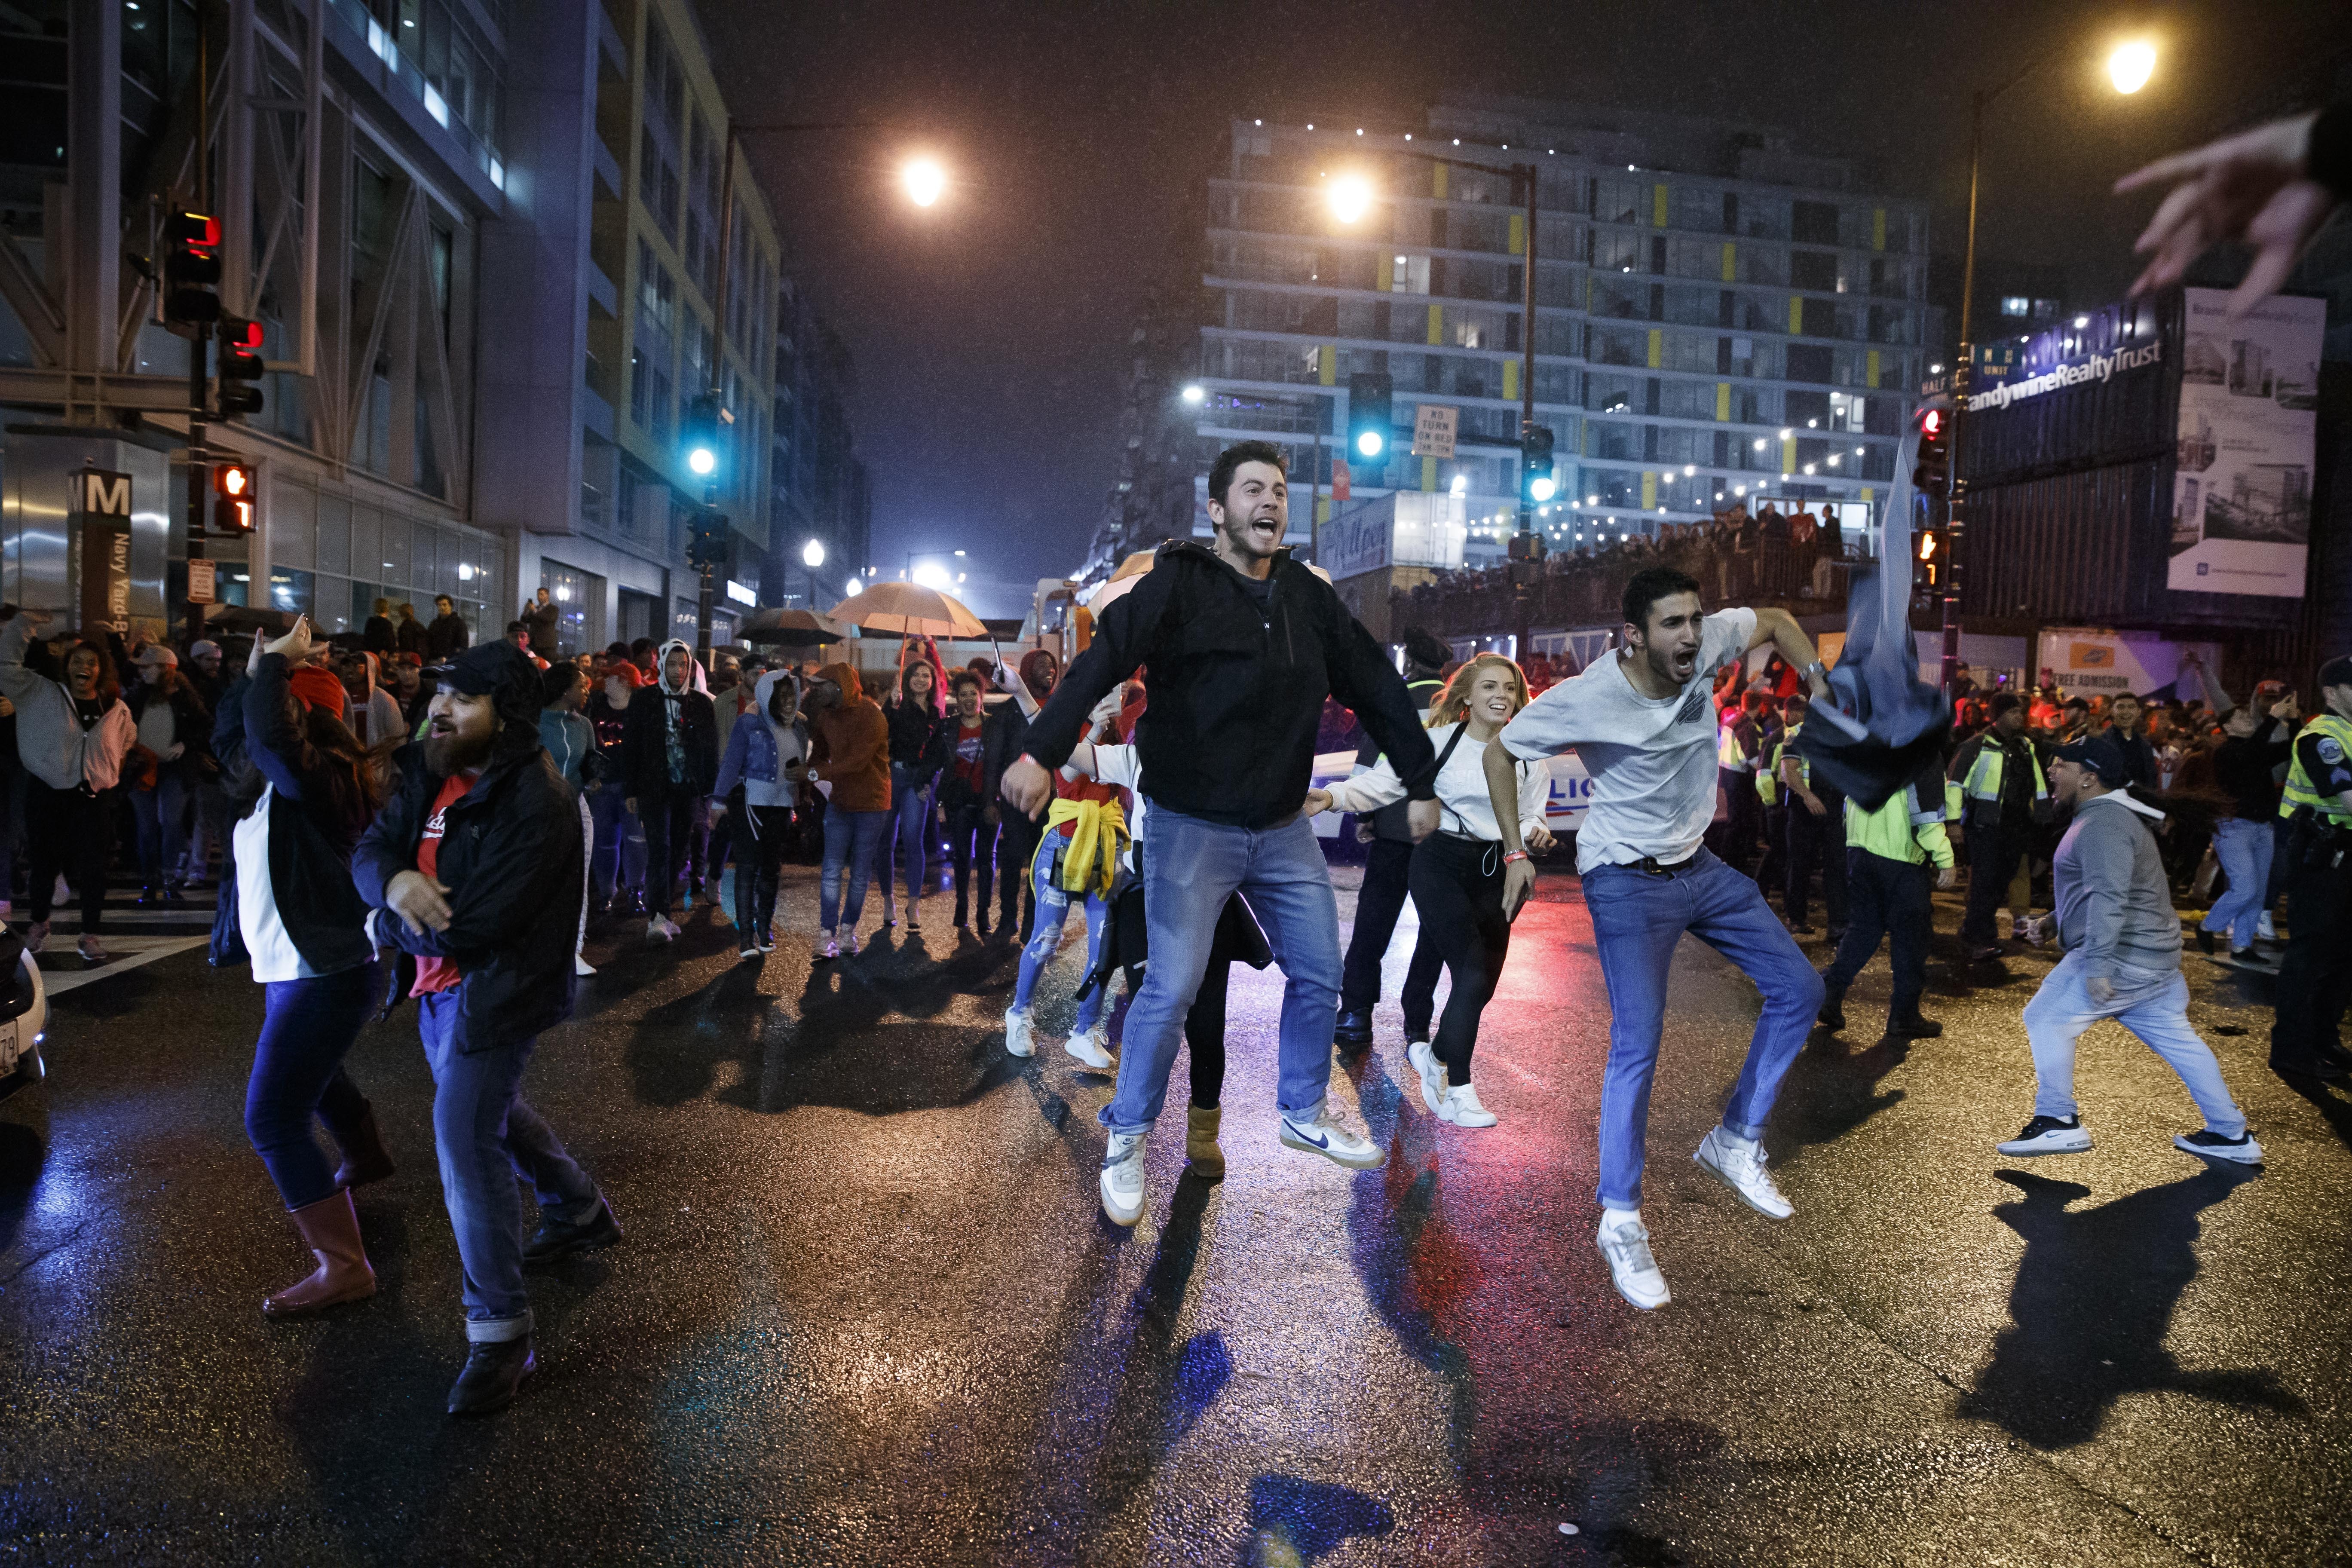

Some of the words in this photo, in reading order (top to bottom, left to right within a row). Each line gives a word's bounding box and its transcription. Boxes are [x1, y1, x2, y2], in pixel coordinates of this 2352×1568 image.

[1968, 340, 2161, 412] andywineRealtyTrust
[1423, 420, 1449, 430] TURN
[1431, 410, 1444, 420] NO
[1419, 431, 1430, 440] ON
[1435, 433, 1452, 443] RED
[87, 474, 129, 515] M
[110, 533, 130, 573] Navy
[113, 577, 130, 640] Yard-B
[2052, 672, 2075, 686] FREE
[2078, 674, 2129, 689] ADMISSION
[1550, 778, 1591, 798] LIC
